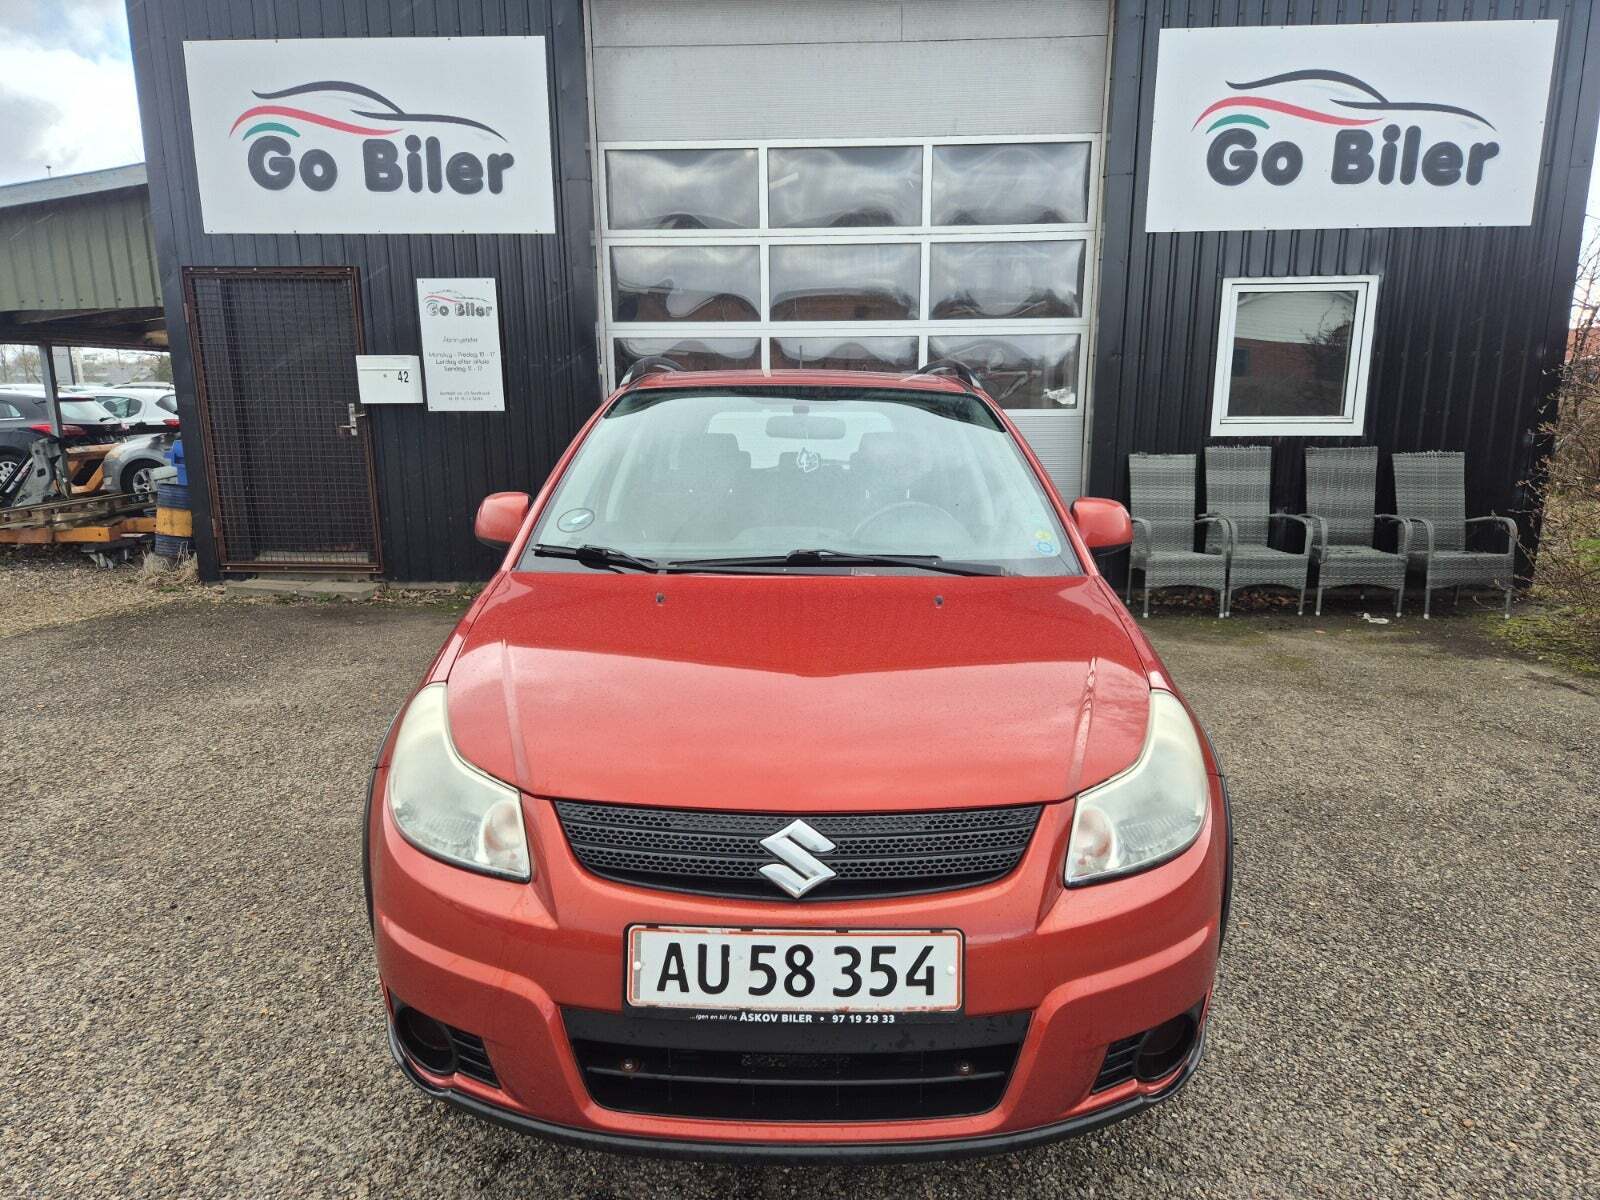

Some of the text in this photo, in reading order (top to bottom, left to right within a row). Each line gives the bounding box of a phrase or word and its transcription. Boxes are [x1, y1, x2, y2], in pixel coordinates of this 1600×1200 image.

[247, 134, 515, 194] Go Biler
[1206, 124, 1500, 186] Go Biler
[426, 302, 493, 317] Go Biler
[397, 370, 409, 383] 42
[656, 942, 935, 998] AU 58 354
[740, 1011, 779, 1022] ÅSKOV
[781, 1013, 813, 1023] BILER
[832, 1014, 845, 1023] 97
[849, 1014, 862, 1023] 19
[865, 1014, 879, 1023] 29
[882, 1014, 895, 1023] 33
